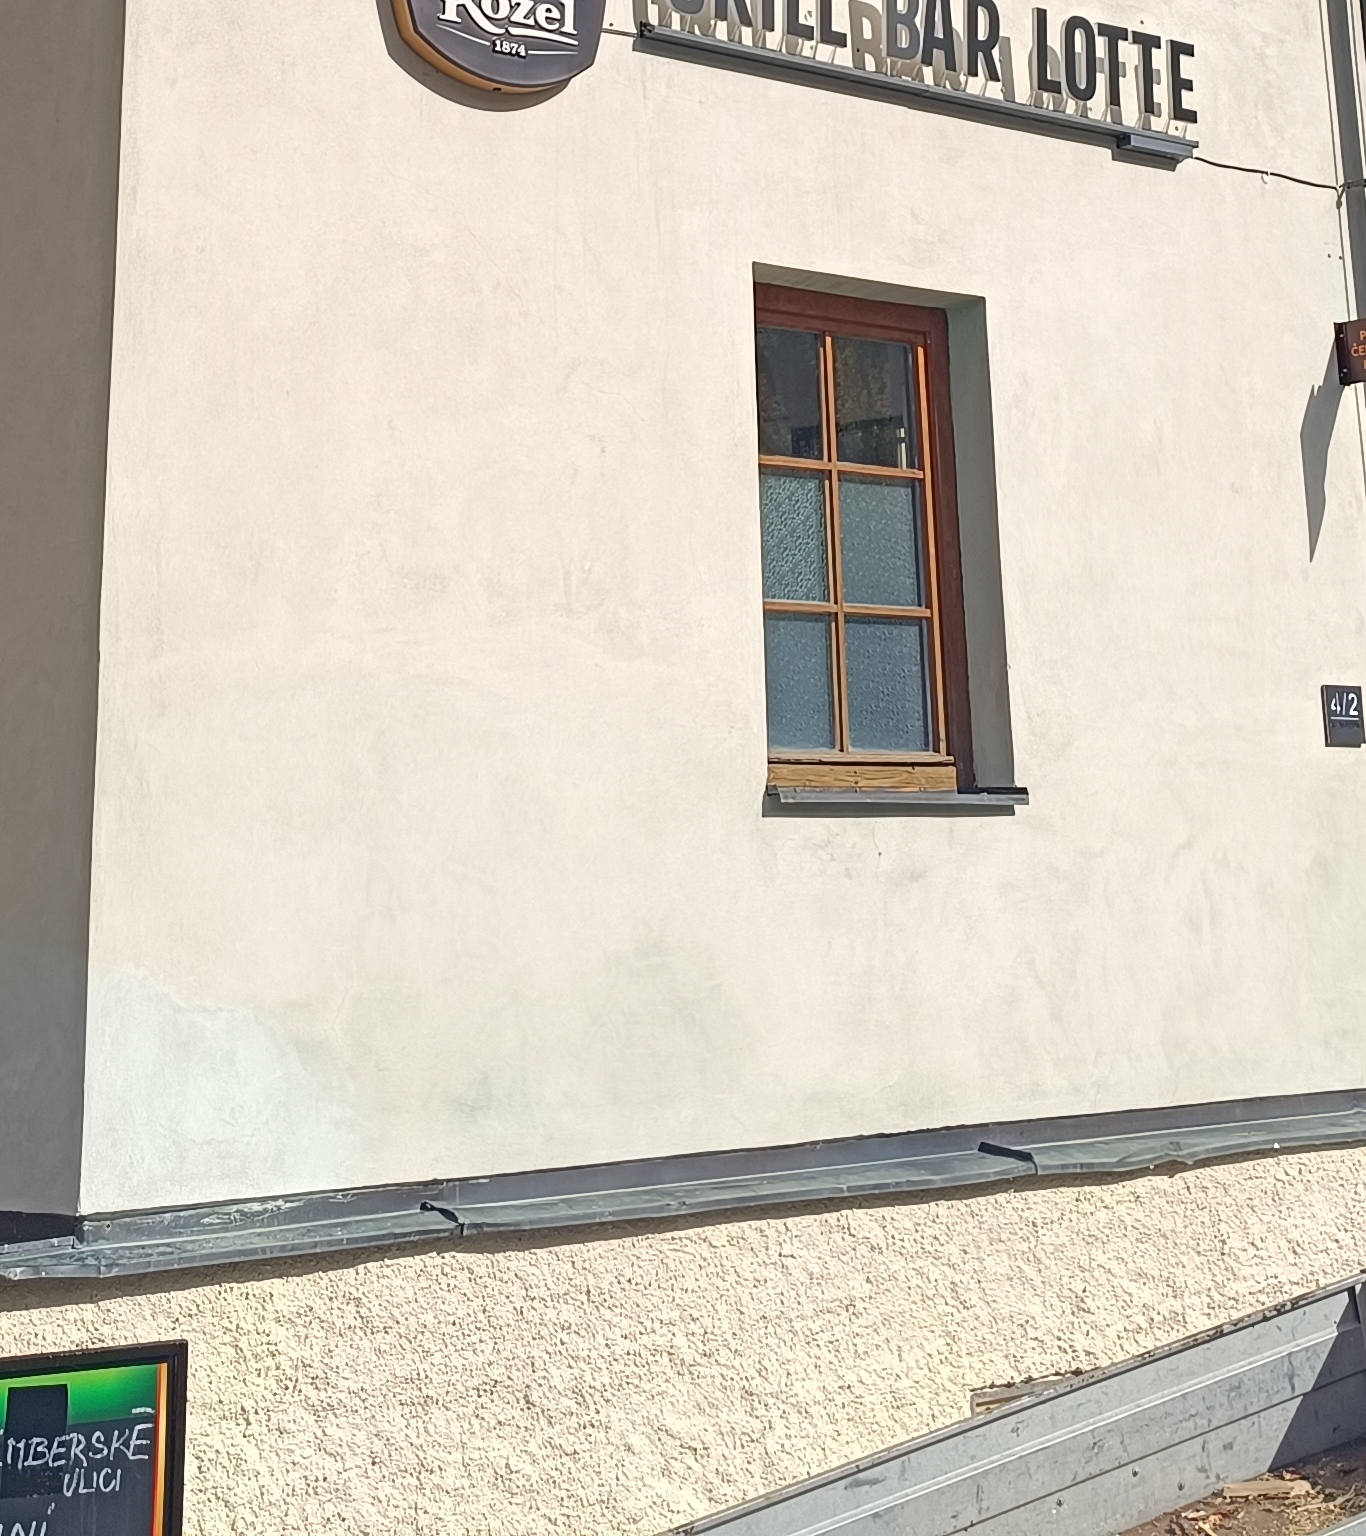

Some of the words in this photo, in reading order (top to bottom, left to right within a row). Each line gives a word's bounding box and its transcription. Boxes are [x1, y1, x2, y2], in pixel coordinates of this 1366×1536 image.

[495, 37, 527, 57] 1874
[1029, 7, 1198, 124] LOTTE
[62, 1467, 121, 1497] ULICI
